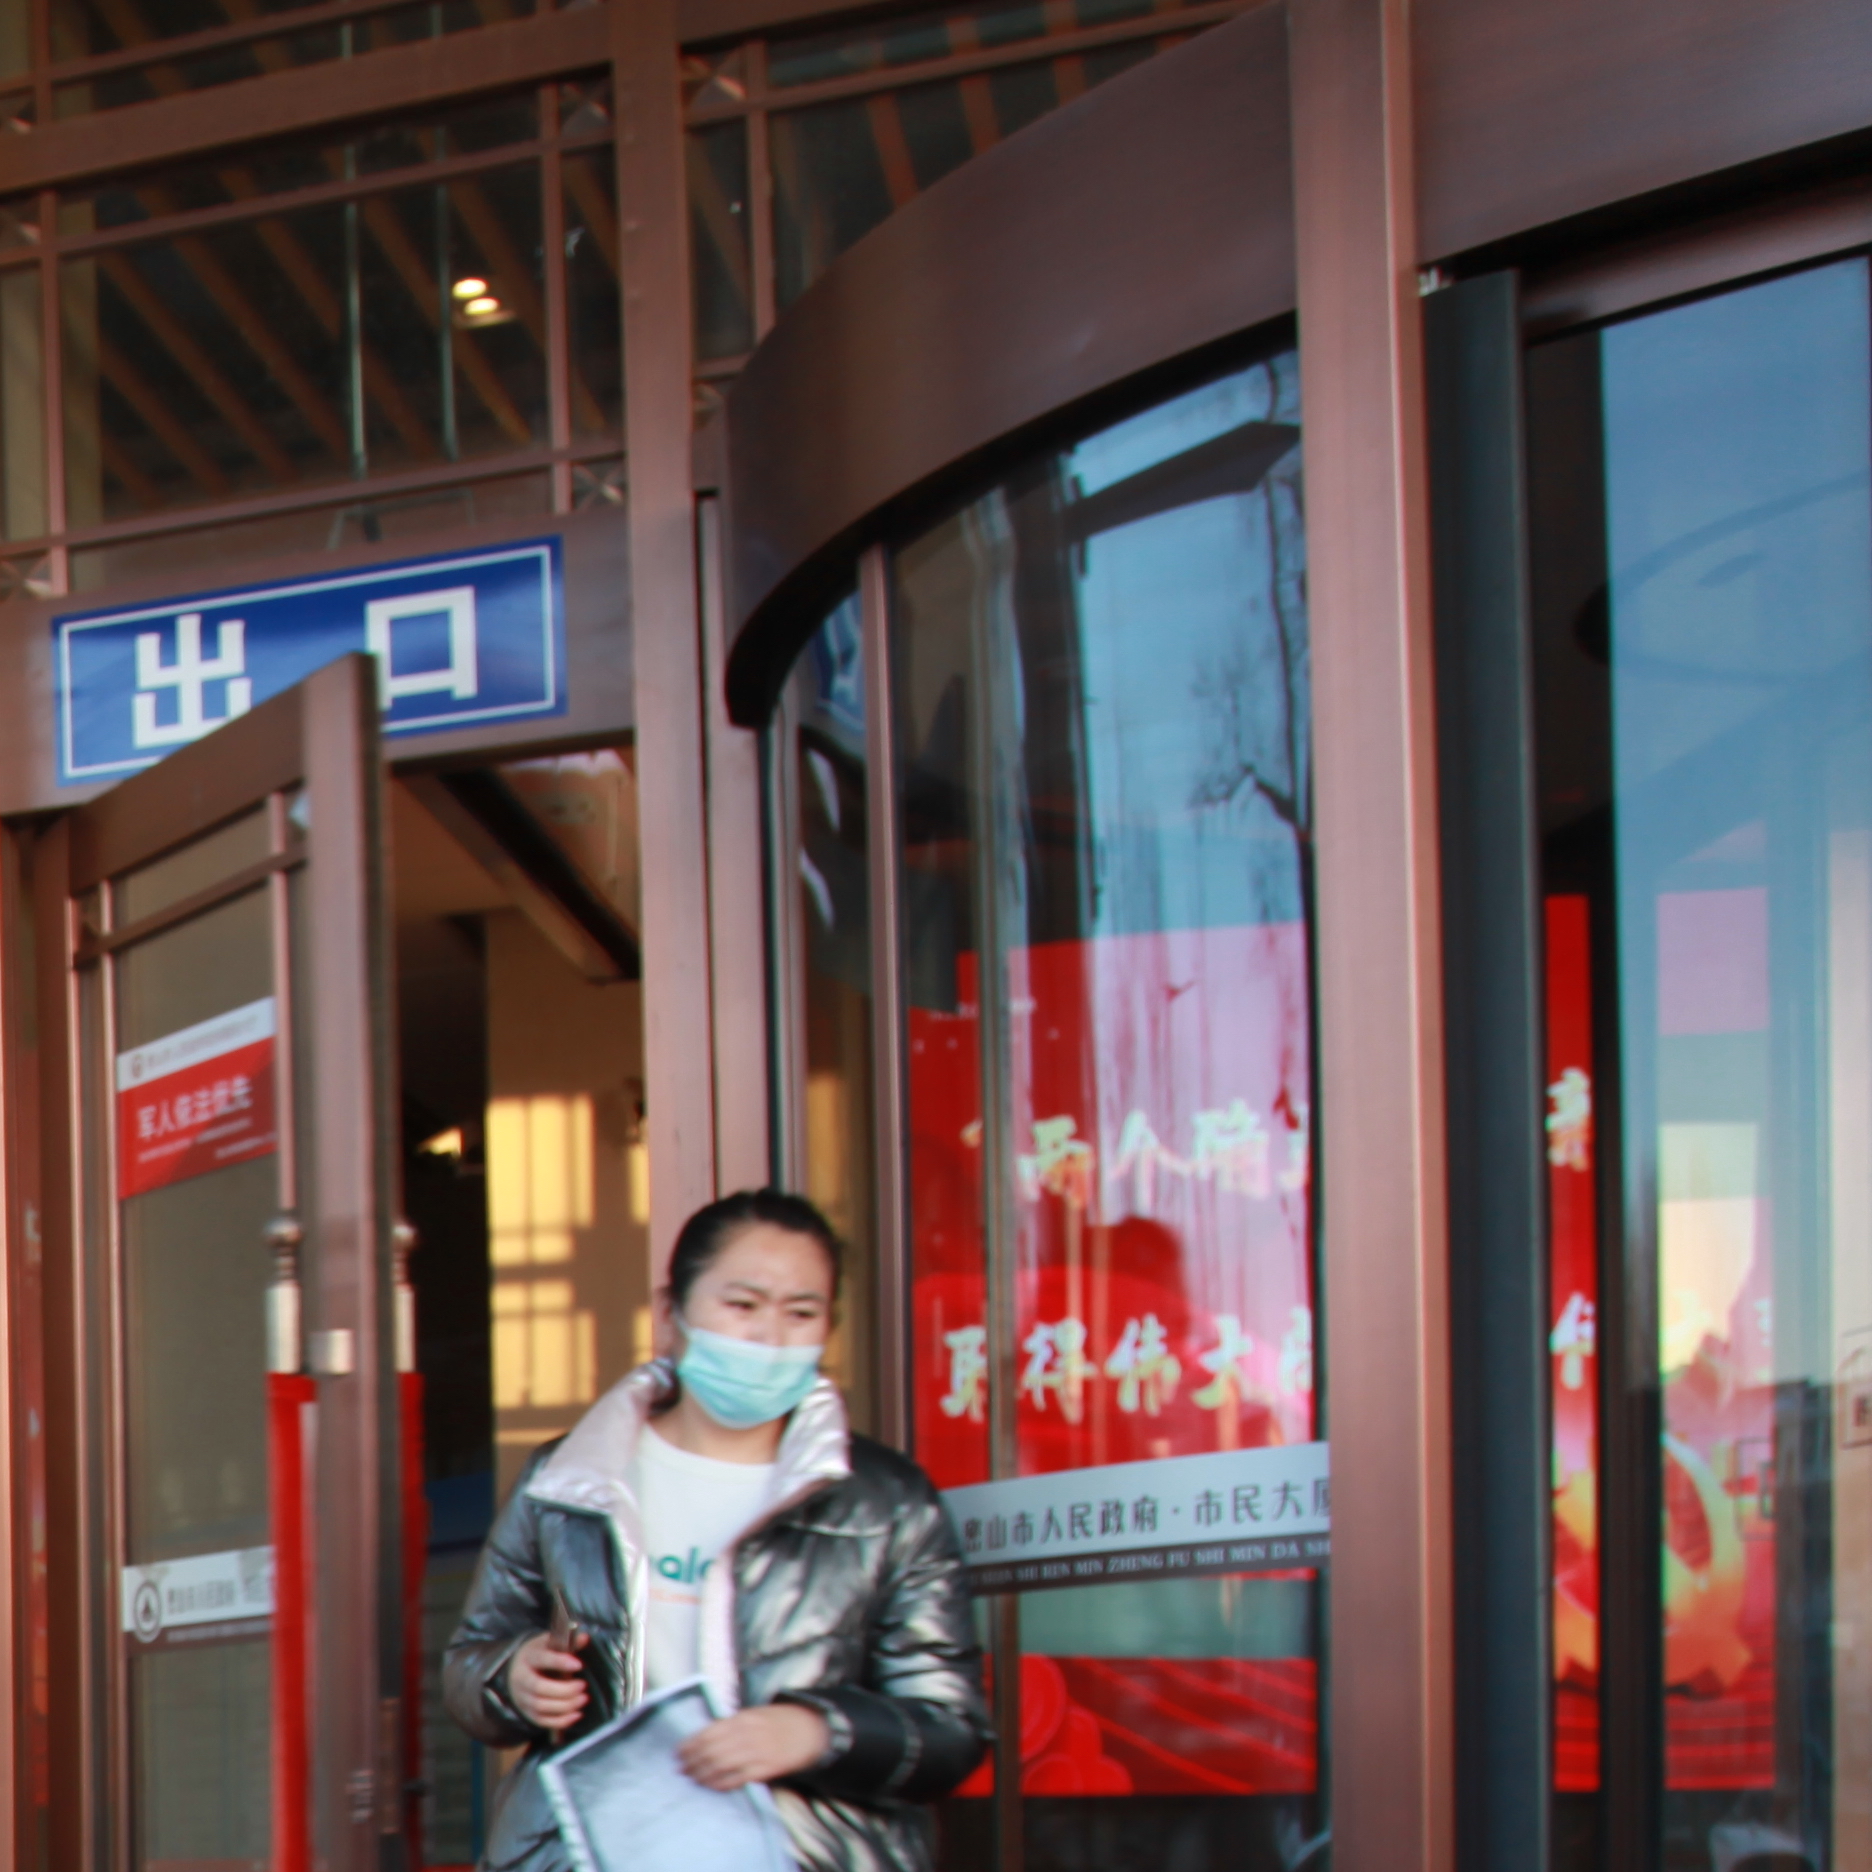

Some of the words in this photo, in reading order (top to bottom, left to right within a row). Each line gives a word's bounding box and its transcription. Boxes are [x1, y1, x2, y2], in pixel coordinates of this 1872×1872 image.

[133, 586, 477, 749] 出口
[1106, 1555, 1164, 1574] ZHENG
[1229, 1544, 1266, 1563] MIN
[1271, 1542, 1300, 1561] DA
